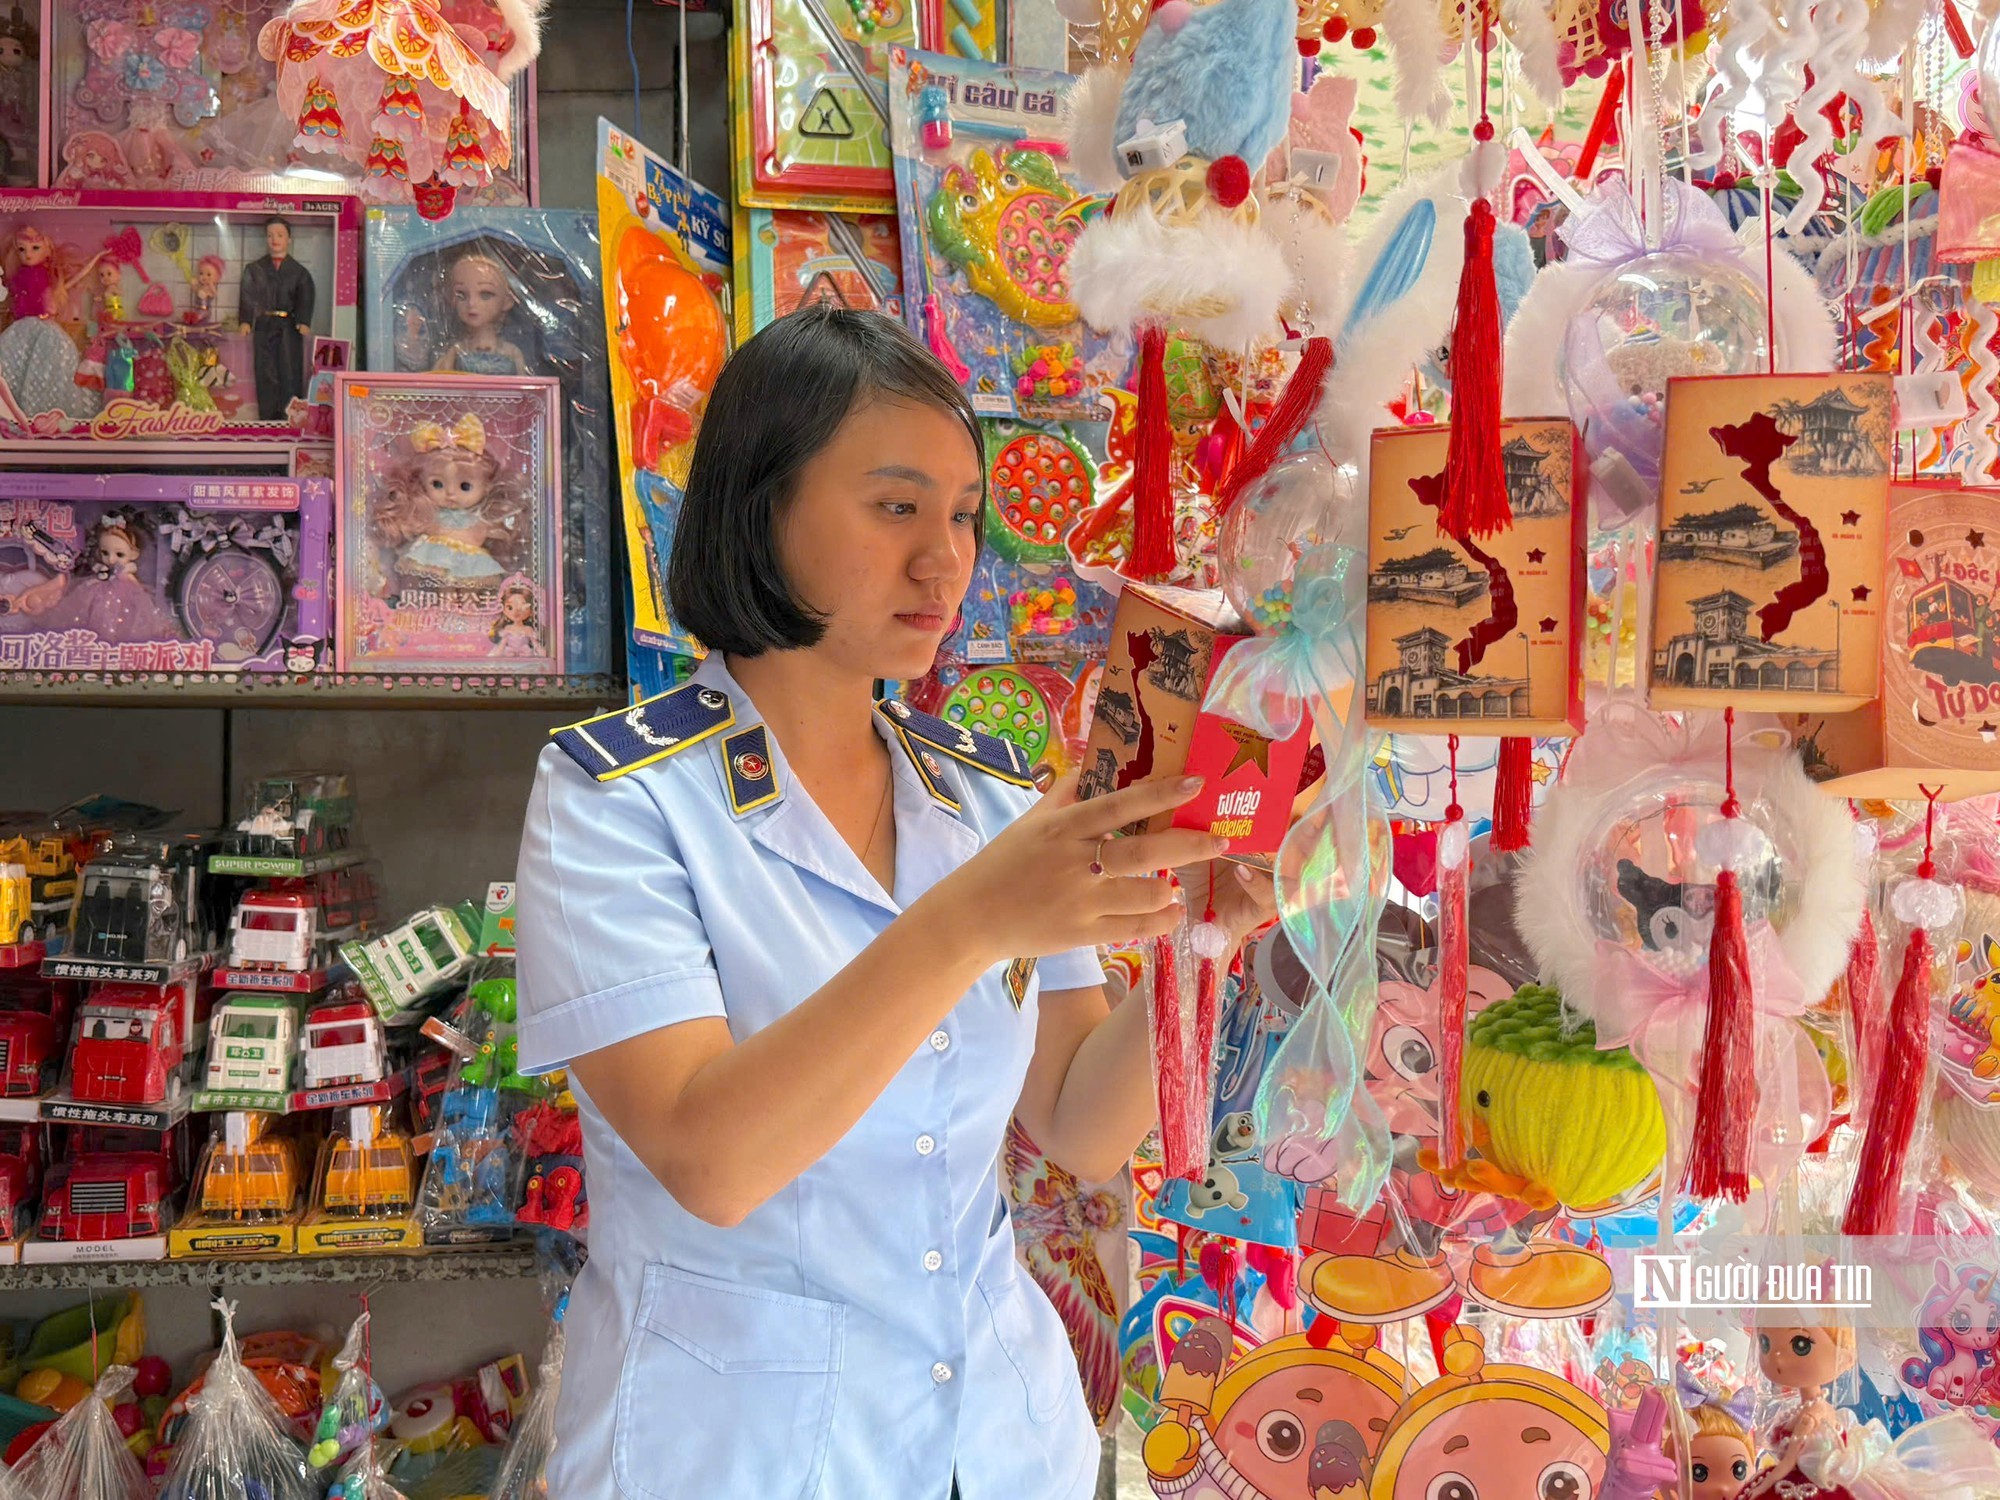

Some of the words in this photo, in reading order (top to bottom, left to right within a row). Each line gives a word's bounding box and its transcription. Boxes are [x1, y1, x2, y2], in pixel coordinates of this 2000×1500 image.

[964, 82, 1016, 111] câu
[1022, 90, 1057, 116] cá
[94, 399, 222, 439] Fashion
[193, 484, 295, 499] 甜酷风黑紫发饰
[1925, 675, 1966, 725] TỰ
[215, 859, 252, 869] SUPER
[254, 861, 296, 872] POWER
[54, 963, 160, 982] 惯性拖头车系列
[52, 1105, 158, 1126] 惯性拖头车系列
[75, 1244, 116, 1253] MODEL
